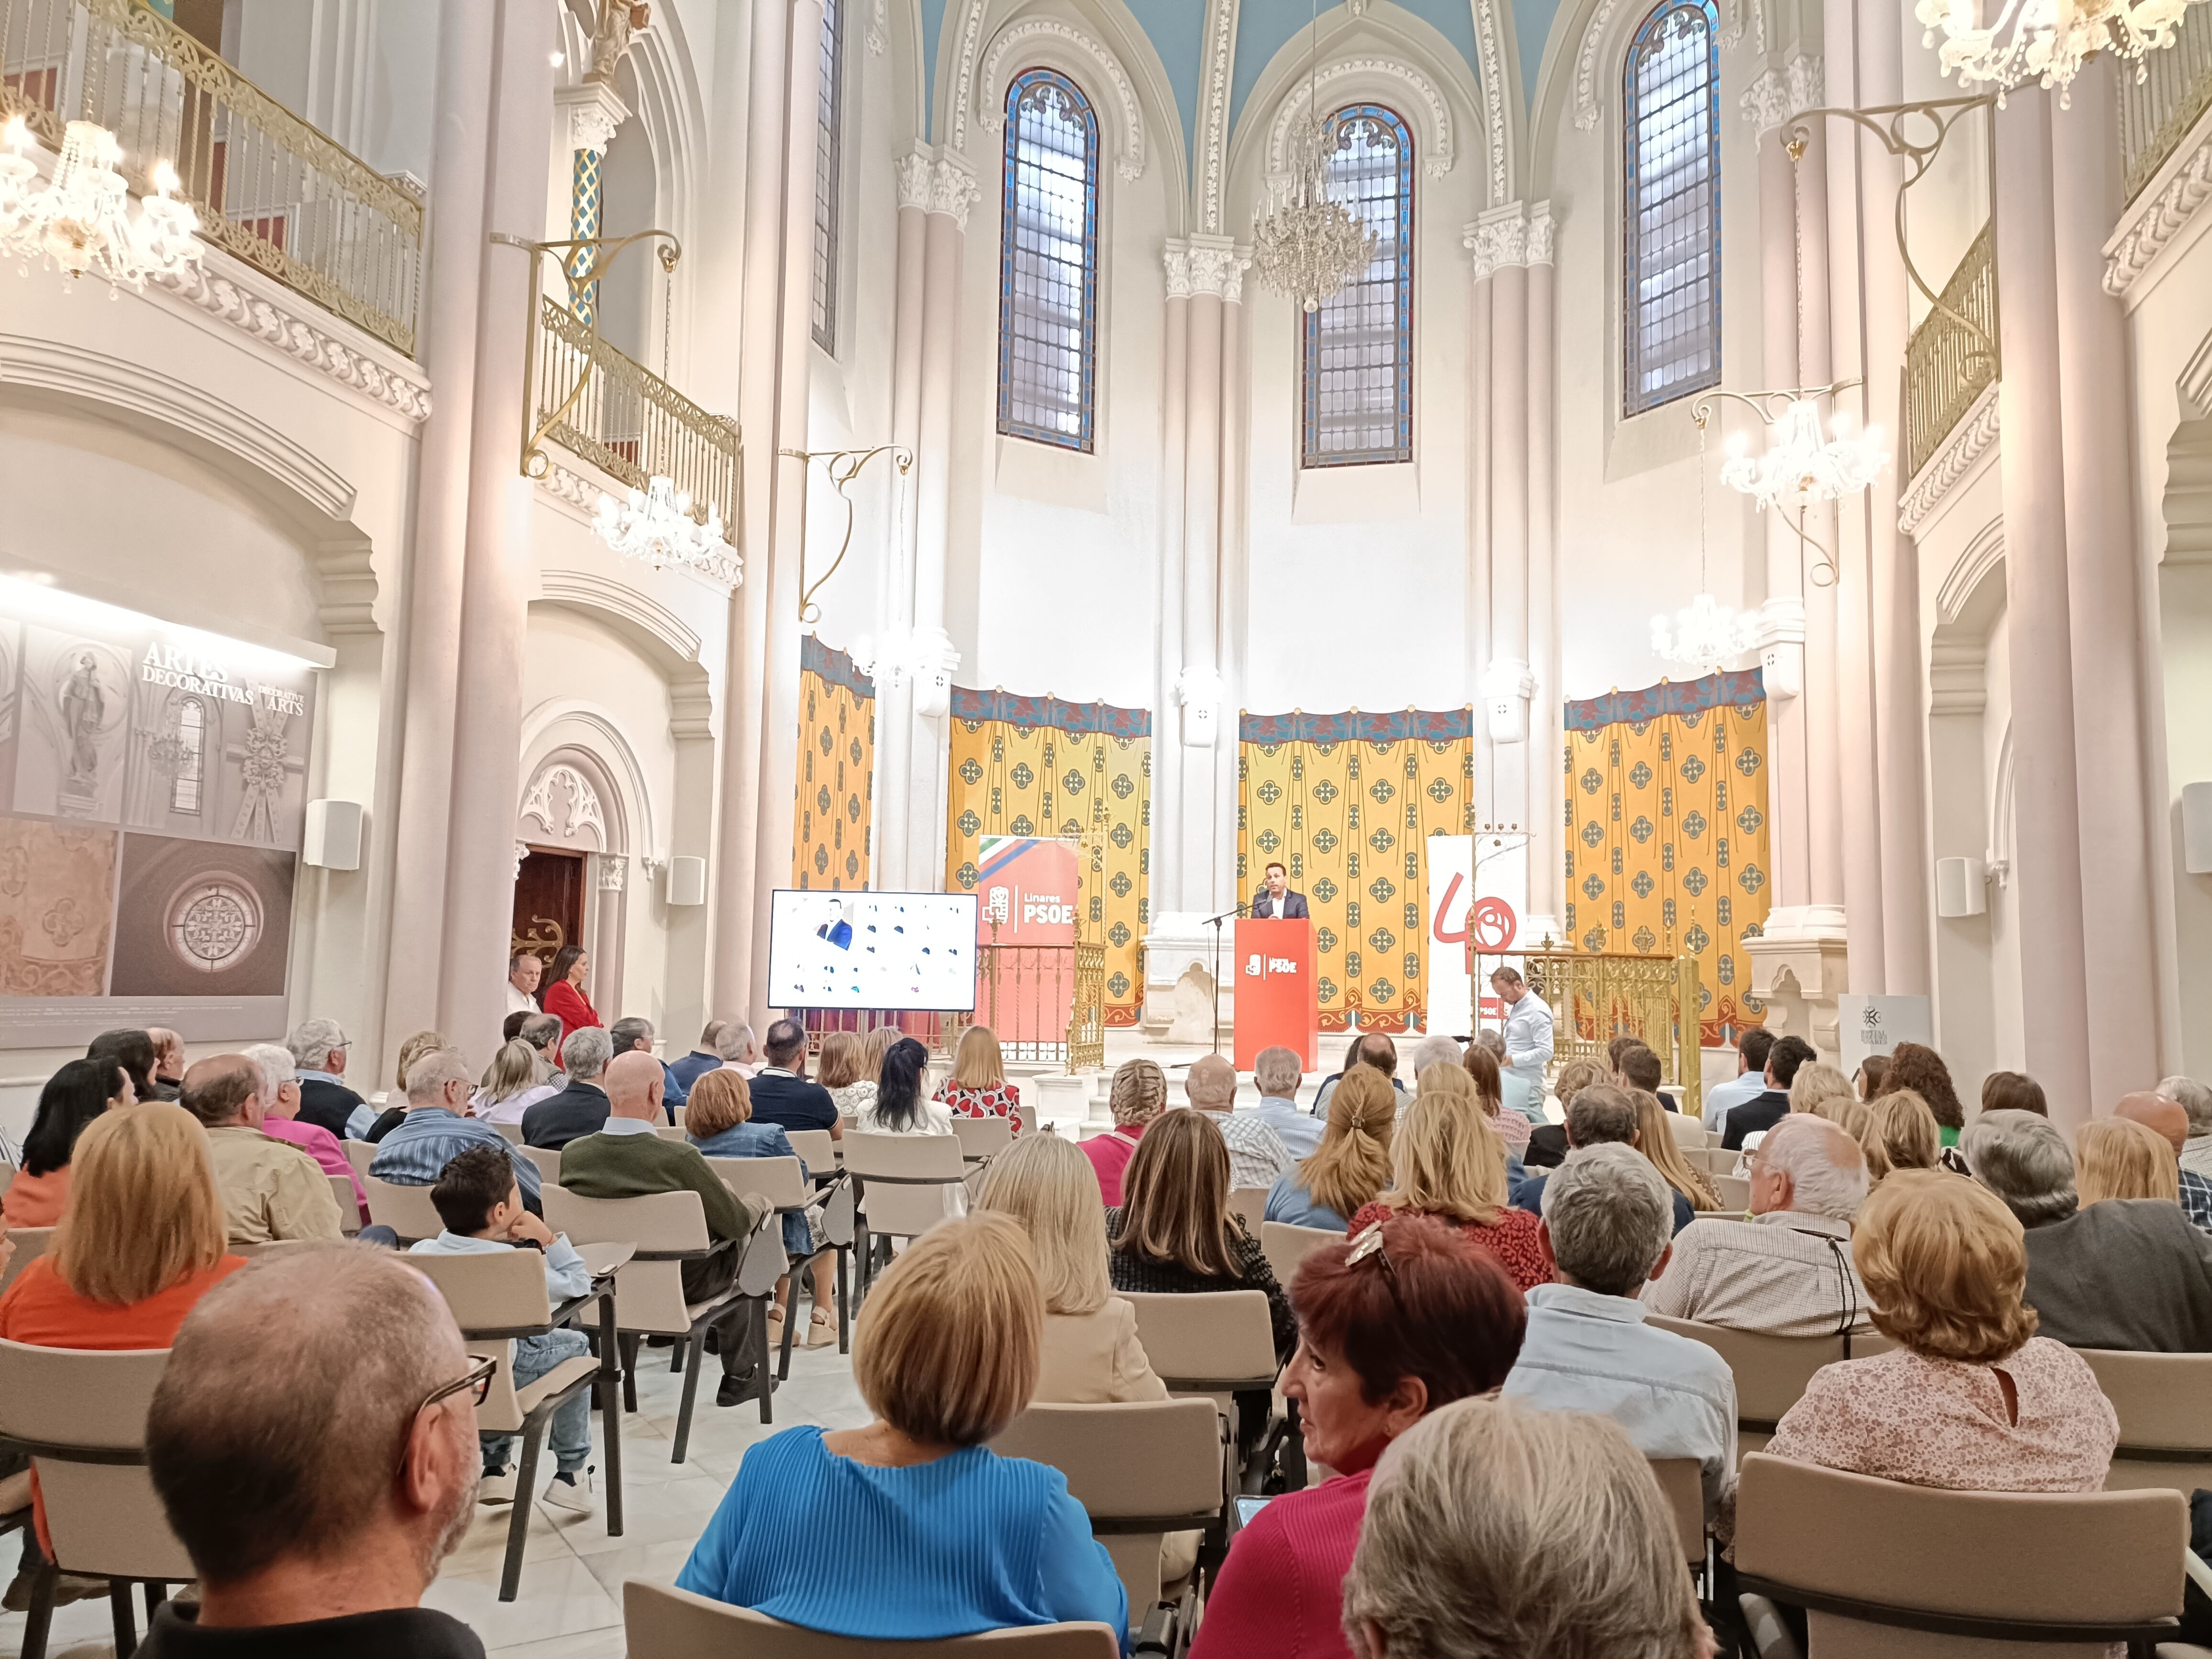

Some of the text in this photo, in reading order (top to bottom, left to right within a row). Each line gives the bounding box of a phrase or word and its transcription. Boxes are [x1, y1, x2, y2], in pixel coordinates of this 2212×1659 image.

[142, 641, 229, 683] ARTES
[142, 664, 254, 706] DECORATIVAS
[258, 685, 305, 703] DECORATIVE
[267, 697, 304, 717] ARTS
[1024, 893, 1061, 903] Linares
[1024, 904, 1073, 924] PSOE
[1268, 961, 1297, 973] PSOE
[1480, 1006, 1497, 1016] PSOE
